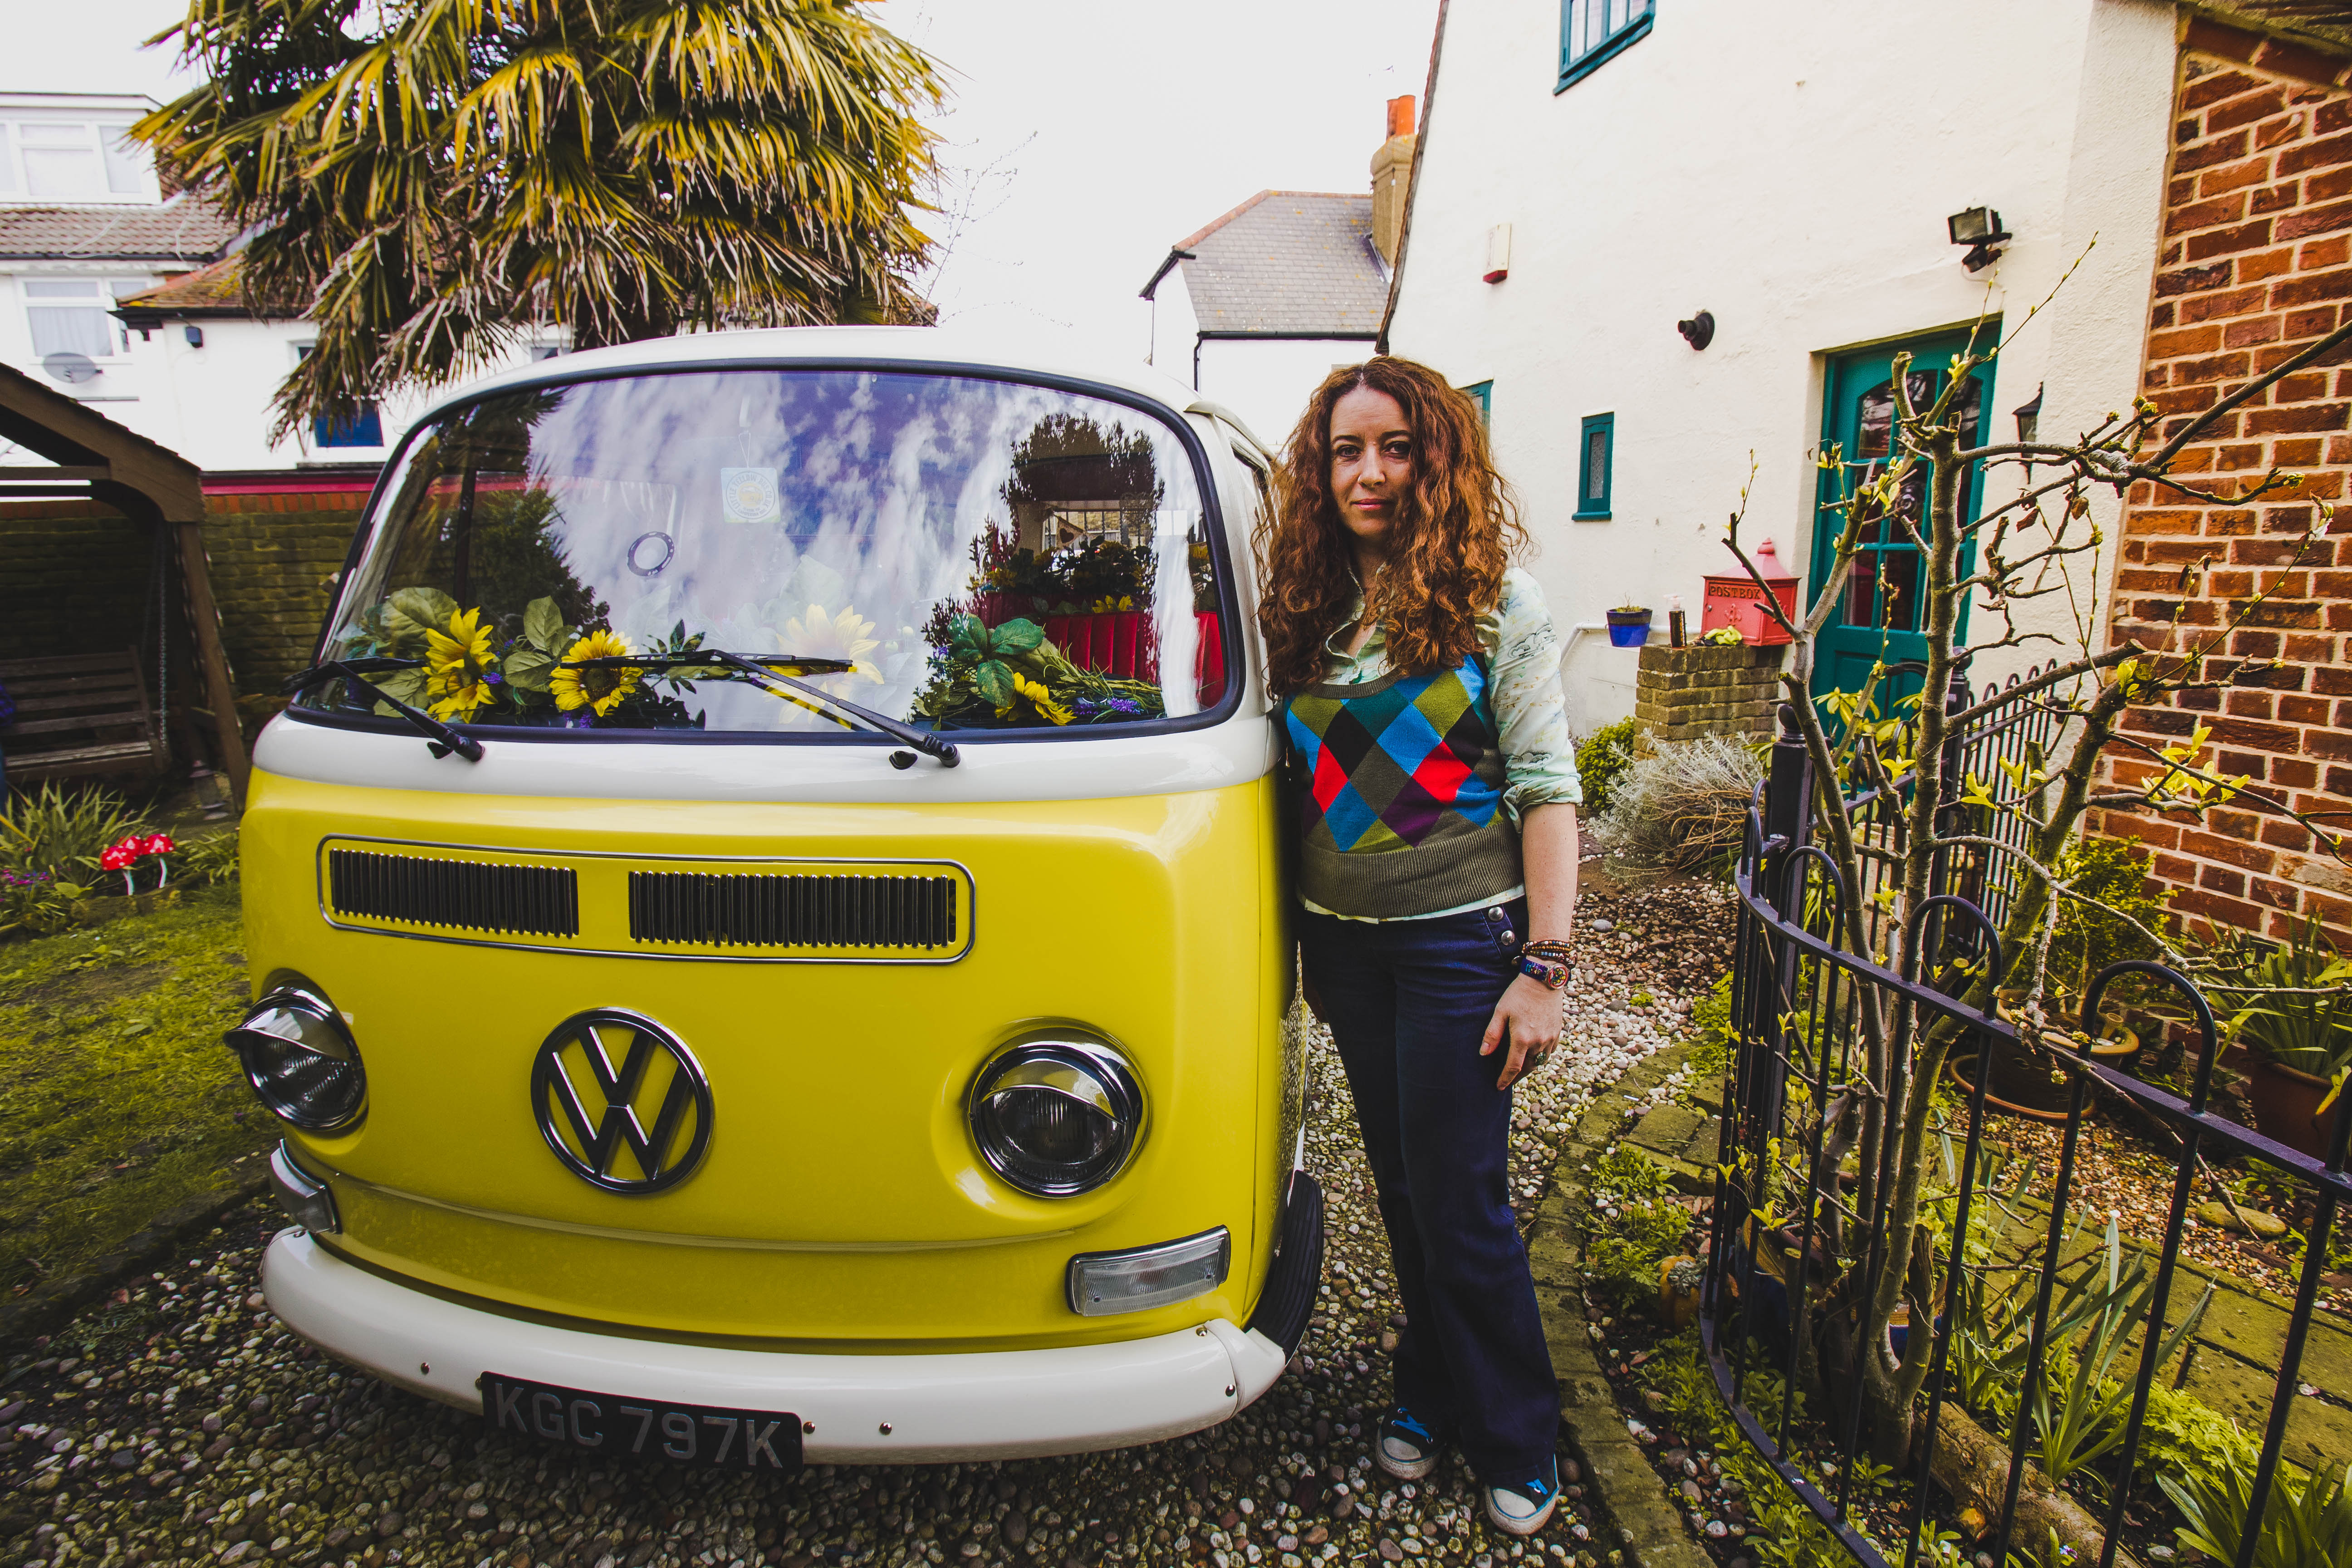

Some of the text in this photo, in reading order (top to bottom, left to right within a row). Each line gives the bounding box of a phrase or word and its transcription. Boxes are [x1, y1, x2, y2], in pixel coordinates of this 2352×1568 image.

[732, 474, 757, 487] YELLOW
[729, 487, 740, 509] LITTLE
[1710, 586, 1760, 599] POSTBOX
[540, 1019, 699, 1185] VW
[495, 1382, 783, 1469] KGC 797K
